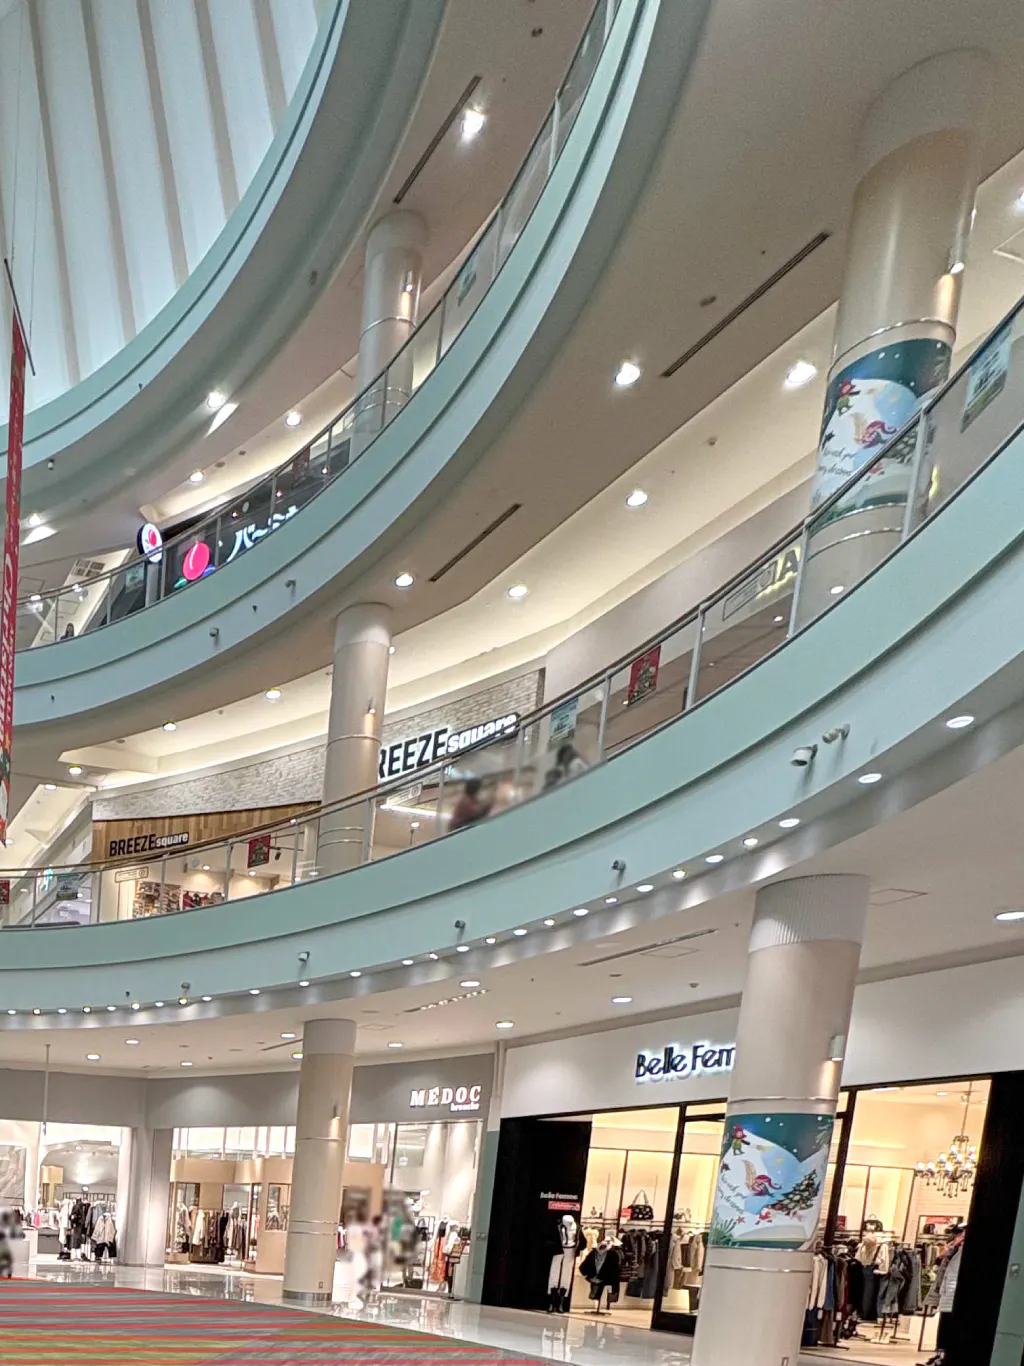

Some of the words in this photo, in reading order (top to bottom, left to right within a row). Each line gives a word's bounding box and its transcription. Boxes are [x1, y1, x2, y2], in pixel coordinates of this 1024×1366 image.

[378, 727, 449, 779] REEZE
[109, 833, 156, 857] BREEZE
[156, 833, 189, 848] square
[635, 1046, 688, 1078] Belle
[691, 1044, 736, 1071] Fem
